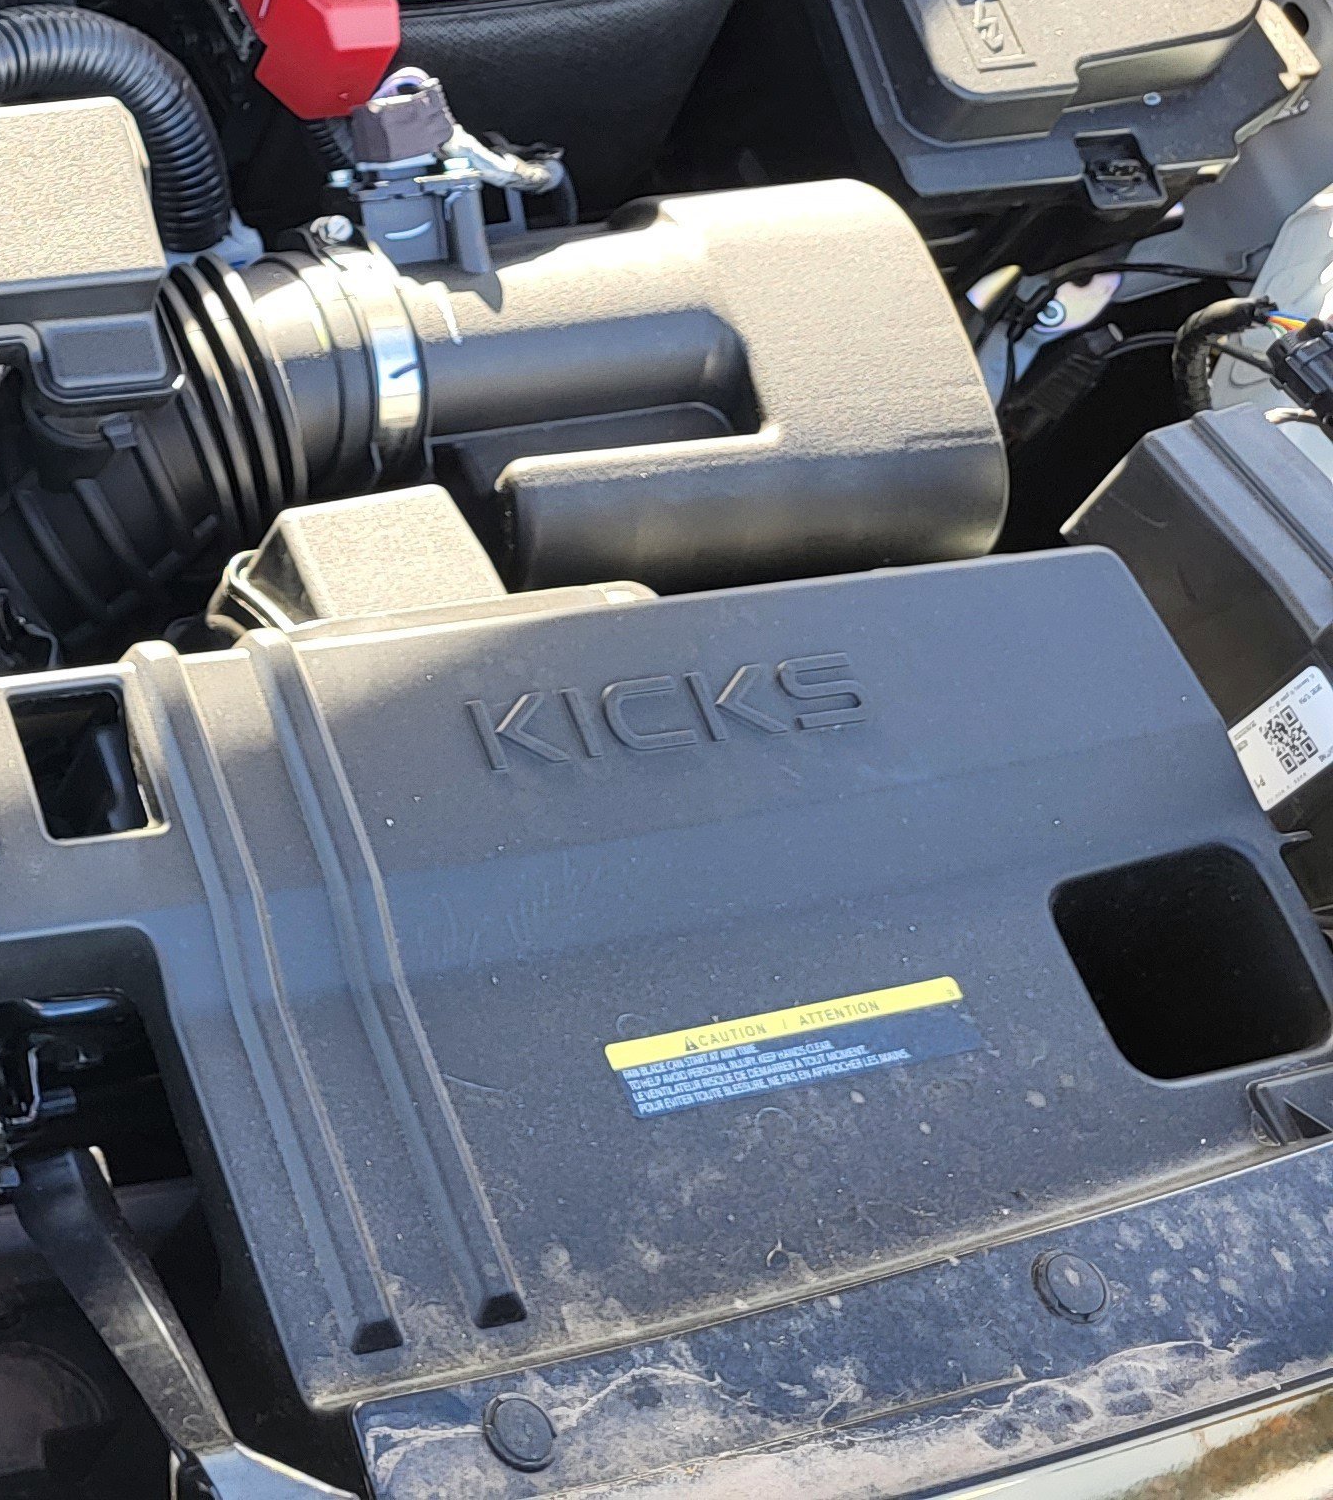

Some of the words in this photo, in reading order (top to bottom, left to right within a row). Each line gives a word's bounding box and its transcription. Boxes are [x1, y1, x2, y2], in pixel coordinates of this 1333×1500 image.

[464, 652, 867, 772] KICKS
[699, 1023, 767, 1047] CAUTION
[799, 999, 880, 1026] ATTENTION
